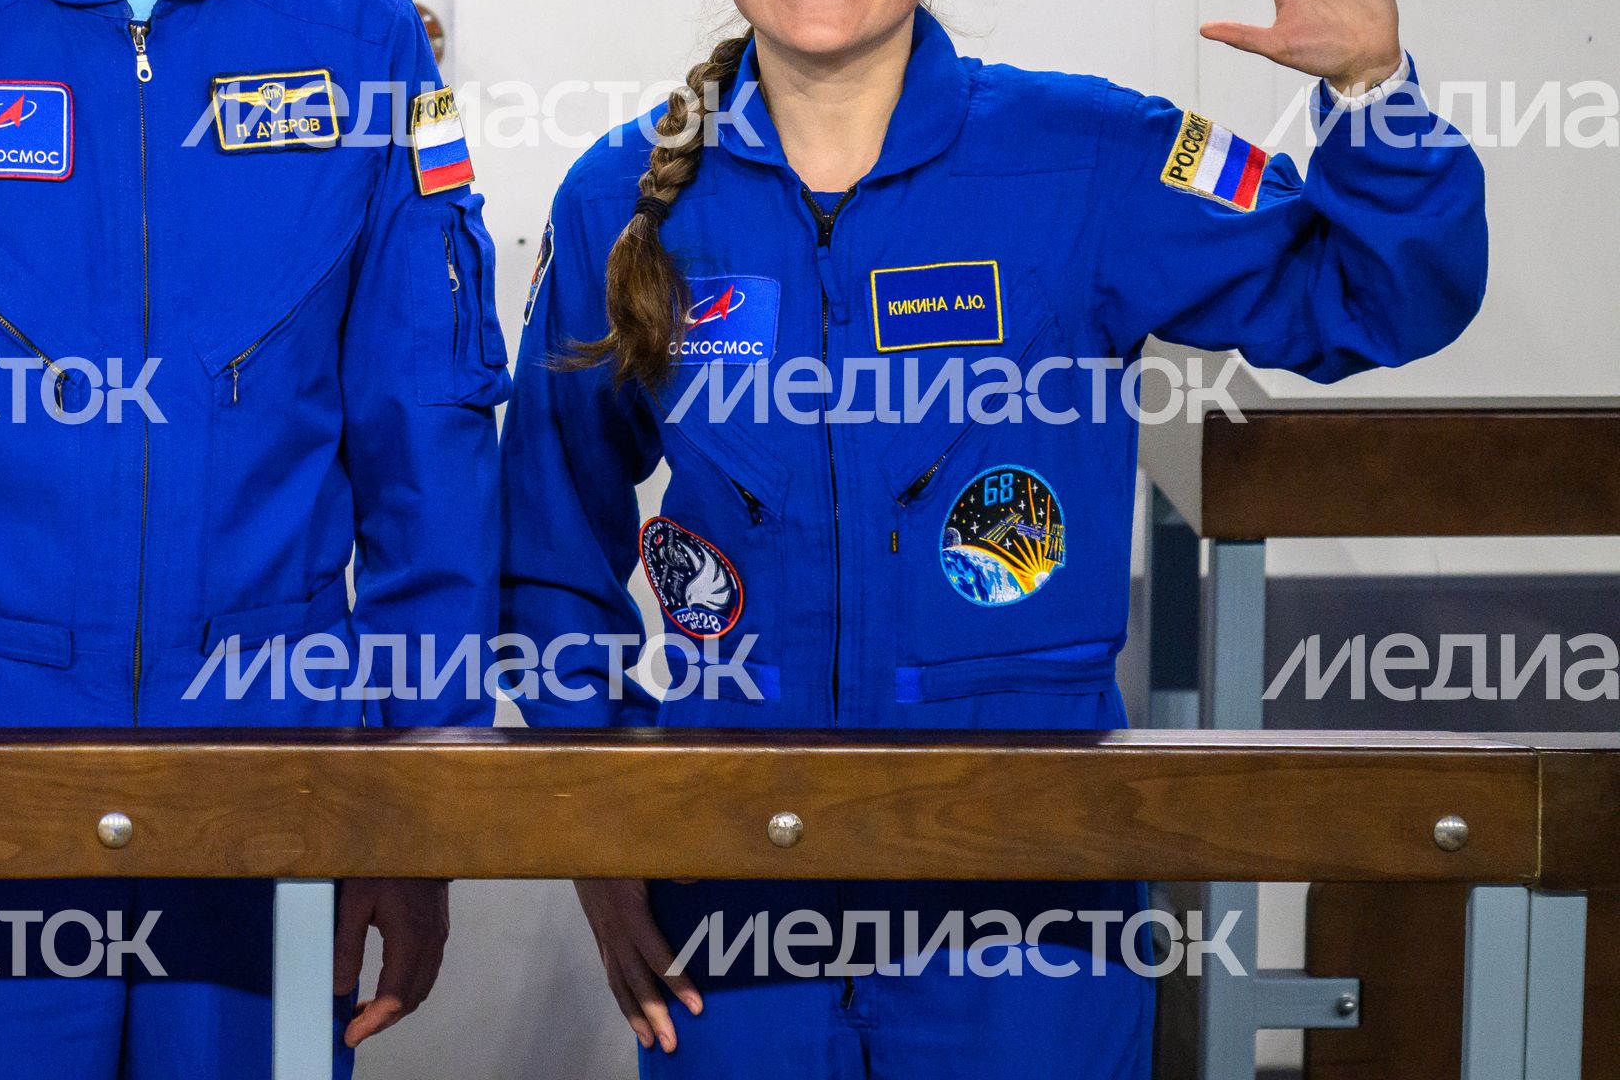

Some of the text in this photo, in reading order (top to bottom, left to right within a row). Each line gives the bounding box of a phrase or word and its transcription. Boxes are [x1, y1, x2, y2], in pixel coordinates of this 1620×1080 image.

[236, 117, 321, 139] П. ДУБРОВ
[1168, 112, 1209, 182] РОССИЯ
[888, 294, 986, 316] КИКИНА А.Ю.
[667, 340, 764, 356] ОСКОСМОС
[984, 472, 1014, 507] 68
[699, 612, 722, 632] 28
